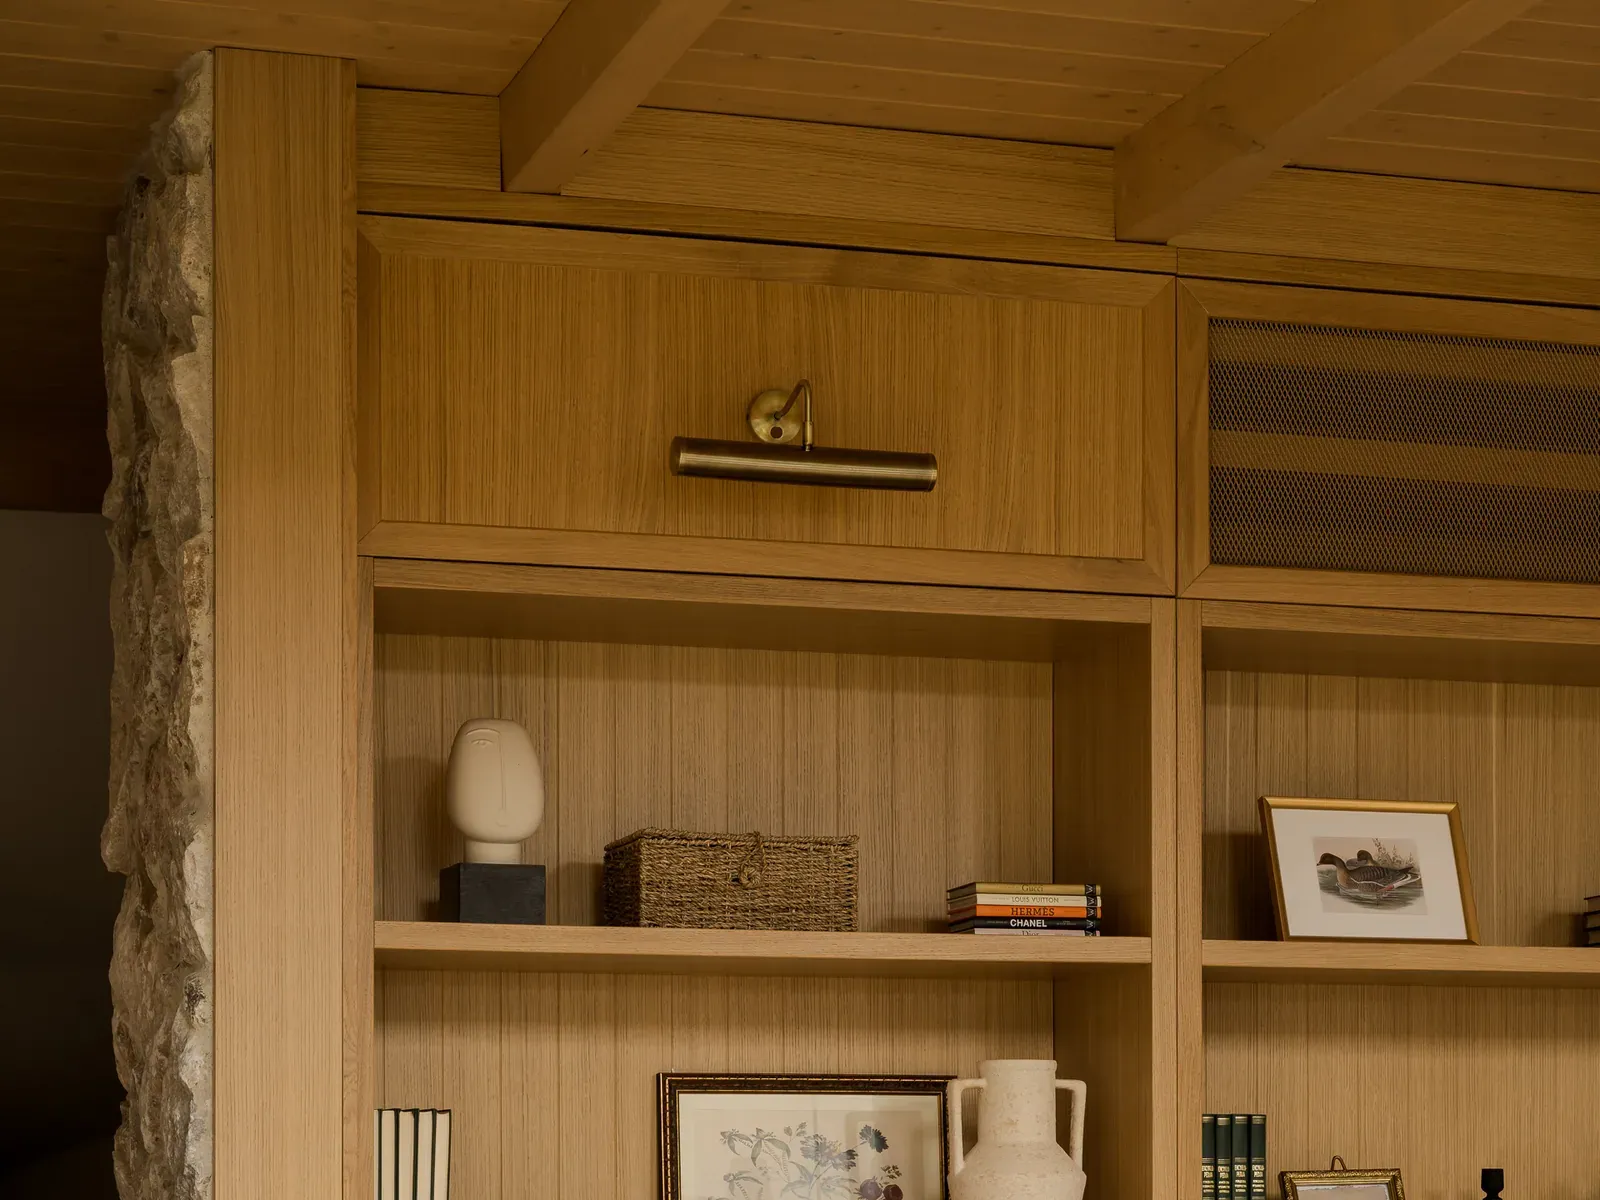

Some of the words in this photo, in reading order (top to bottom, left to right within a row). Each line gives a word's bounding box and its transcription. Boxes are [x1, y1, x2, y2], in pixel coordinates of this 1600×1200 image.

[1021, 884, 1044, 893] Gucci
[1031, 896, 1059, 904] VUITTON
[1011, 906, 1055, 917] HERMÈS
[1009, 918, 1048, 928] CHANEL
